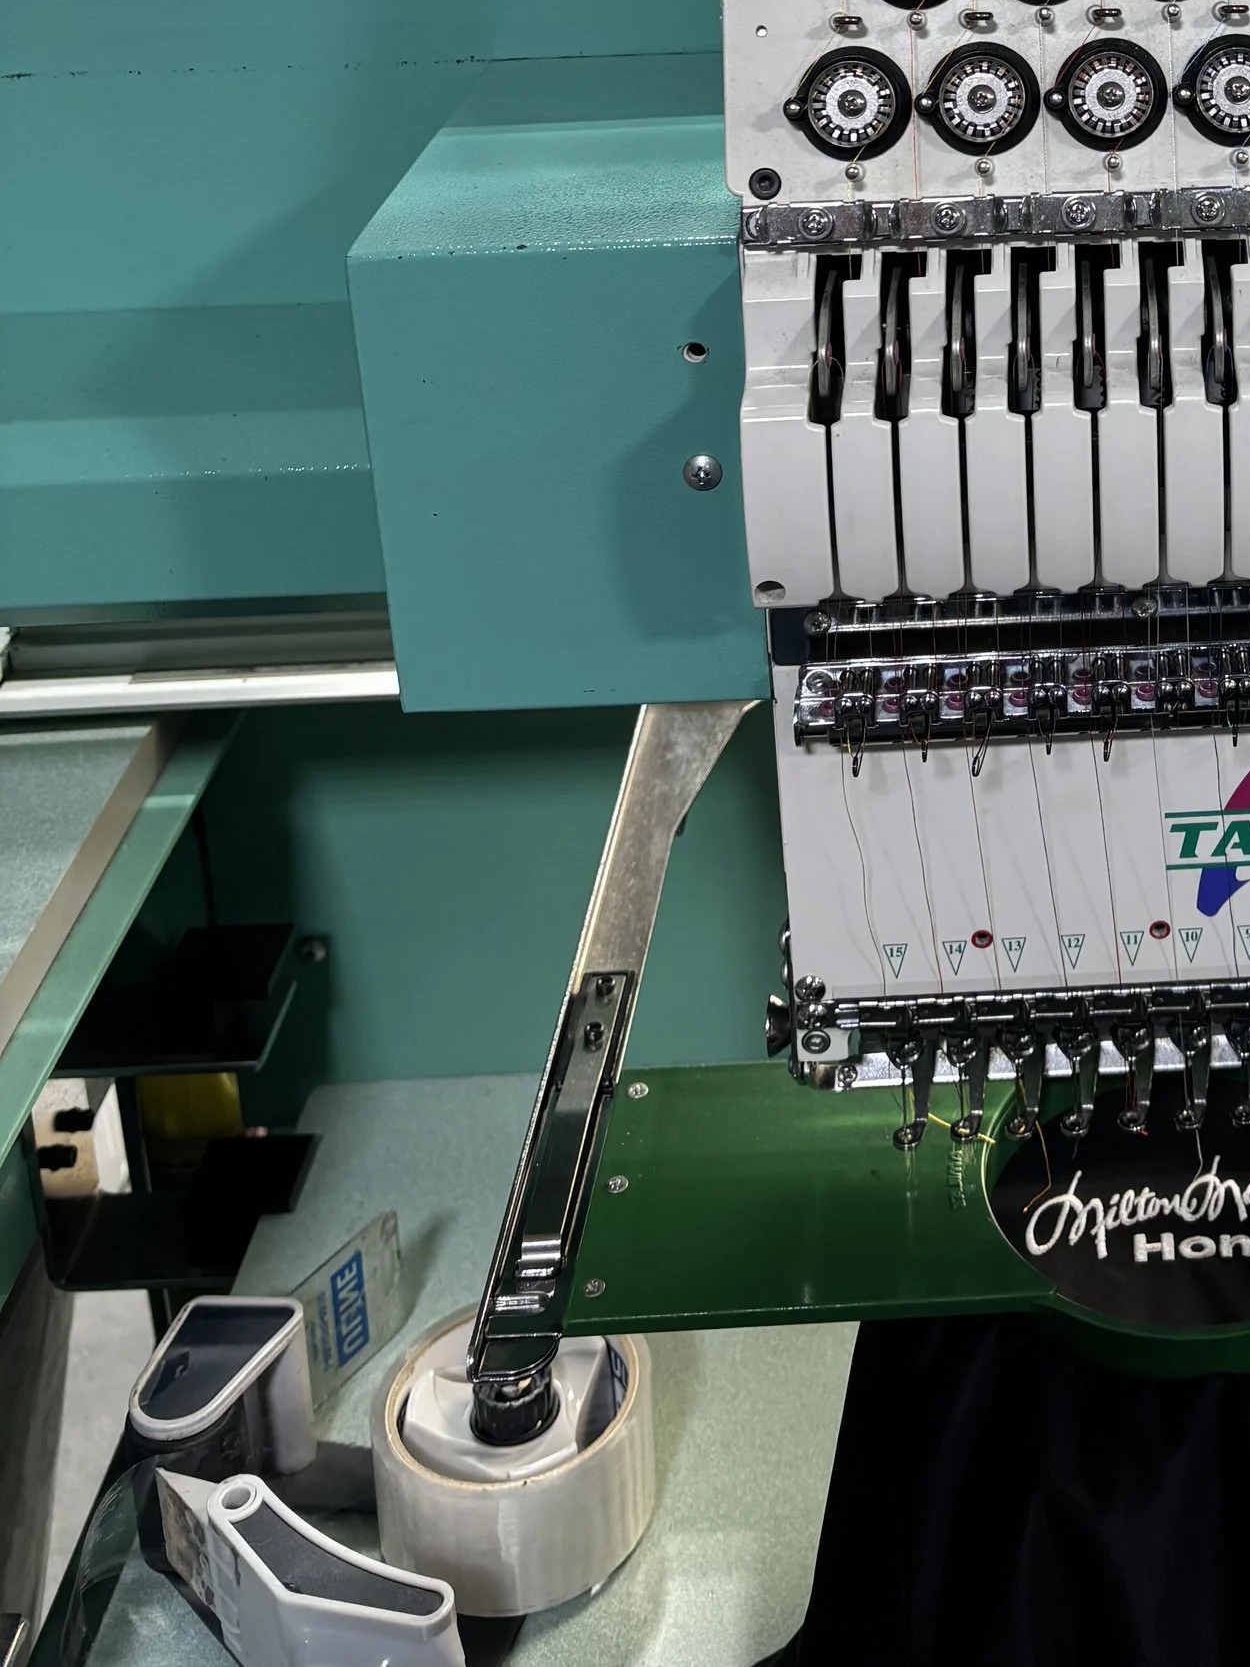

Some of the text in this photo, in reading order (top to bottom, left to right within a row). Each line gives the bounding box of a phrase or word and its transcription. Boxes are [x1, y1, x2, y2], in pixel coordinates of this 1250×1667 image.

[889, 947, 904, 959] 15
[948, 943, 963, 955] 14
[1008, 940, 1022, 952] 13
[1066, 937, 1080, 949] 12
[1126, 934, 1139, 945] 11
[1185, 931, 1198, 942] 10
[1024, 1170, 1189, 1259] Milton
